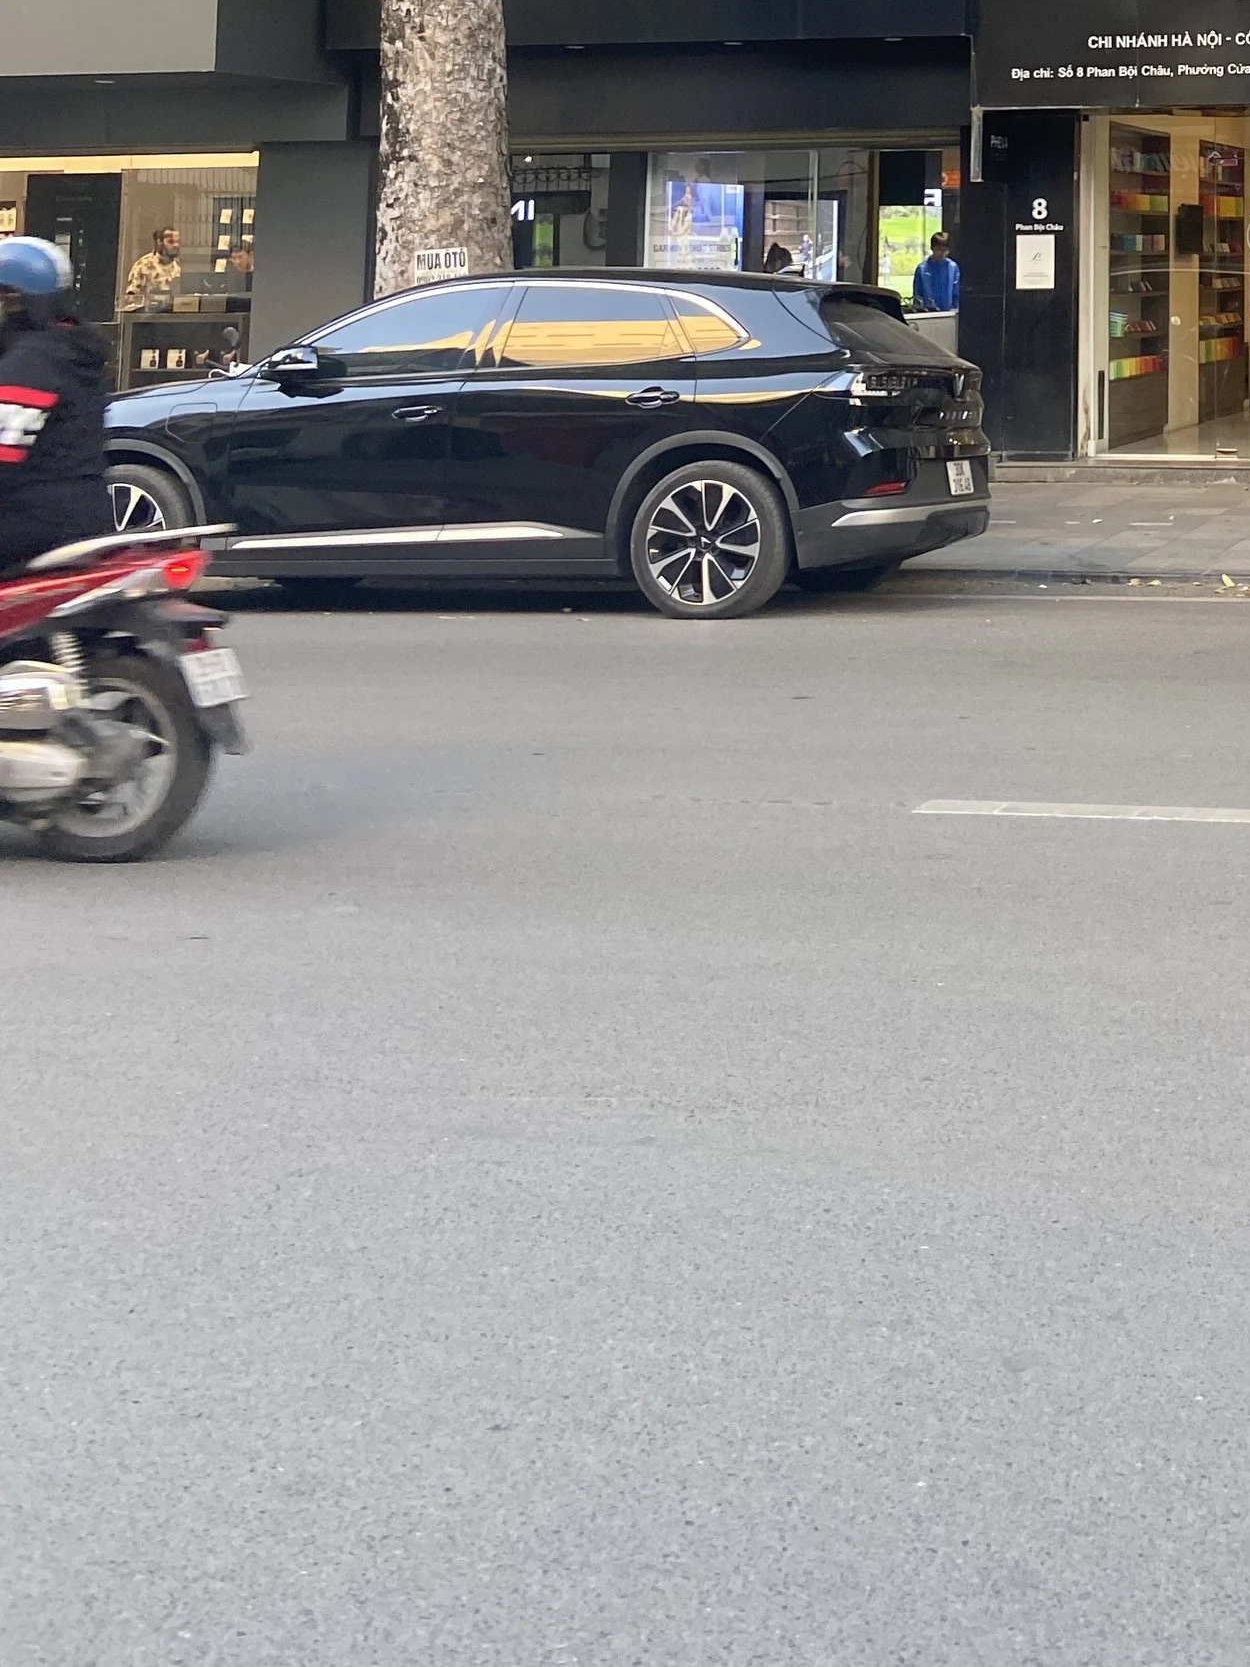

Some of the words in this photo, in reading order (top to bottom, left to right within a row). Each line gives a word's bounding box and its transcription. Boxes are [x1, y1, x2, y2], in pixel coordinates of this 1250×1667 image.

[1087, 36, 1112, 49] CHI
[1116, 32, 1168, 48] NHÁNH
[1171, 31, 1193, 47] HÀ
[1197, 30, 1222, 50] NỘI
[1011, 67, 1030, 81] Địa
[1058, 64, 1074, 78] Số
[1076, 67, 1084, 77] 8
[1086, 66, 1116, 77] Phan
[1119, 65, 1138, 79] Bội
[1141, 64, 1174, 77] Châu,
[1032, 198, 1047, 219] 8
[417, 251, 442, 270] MUA
